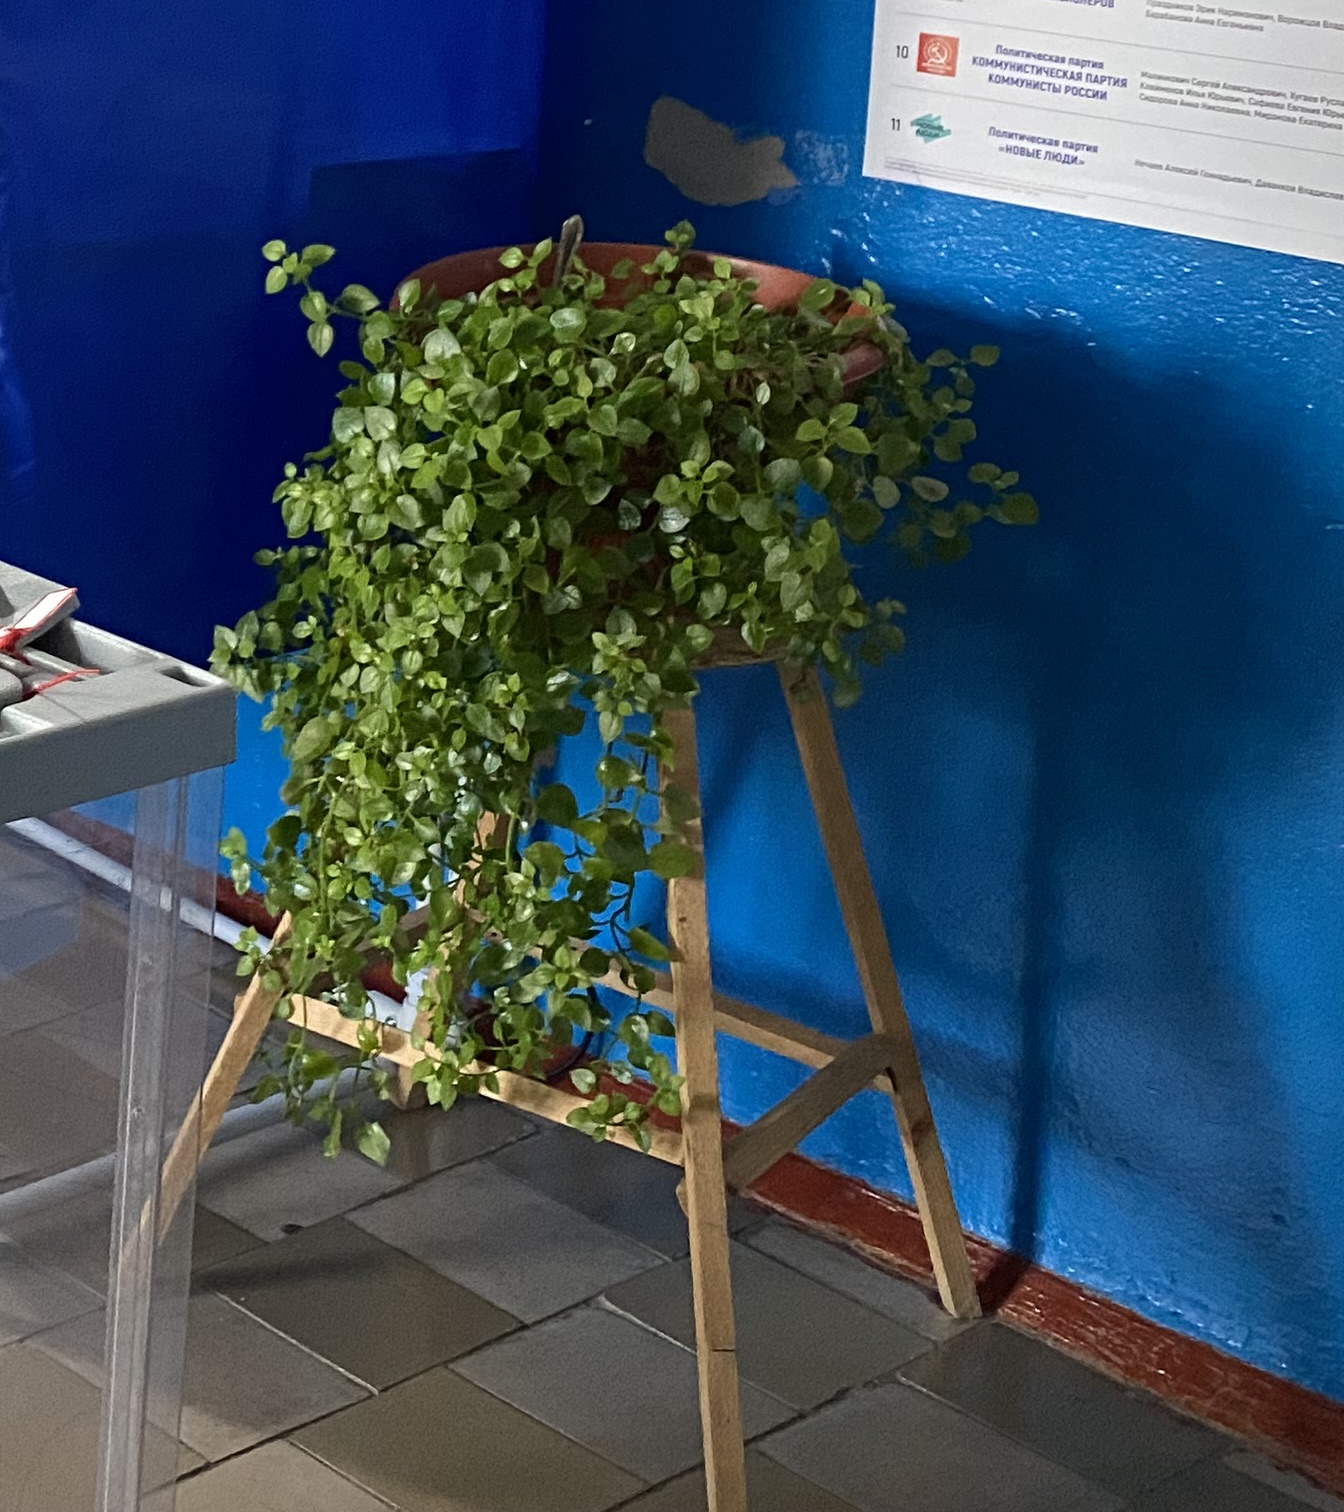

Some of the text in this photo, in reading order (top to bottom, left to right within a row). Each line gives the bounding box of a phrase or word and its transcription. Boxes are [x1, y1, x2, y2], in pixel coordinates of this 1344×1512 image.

[896, 45, 909, 59] 10
[995, 44, 1104, 70] Политическая партия
[971, 56, 1128, 89] КОММУНИСТИЧЕСКАЯ ПАРТИЯ
[988, 73, 1108, 101] КОММУНИСТЫ РОССИИ
[891, 118, 901, 132] 11
[988, 126, 1099, 154] Политическая партия
[998, 145, 1085, 166] «НОВЫЕ ЛЮДИ»
